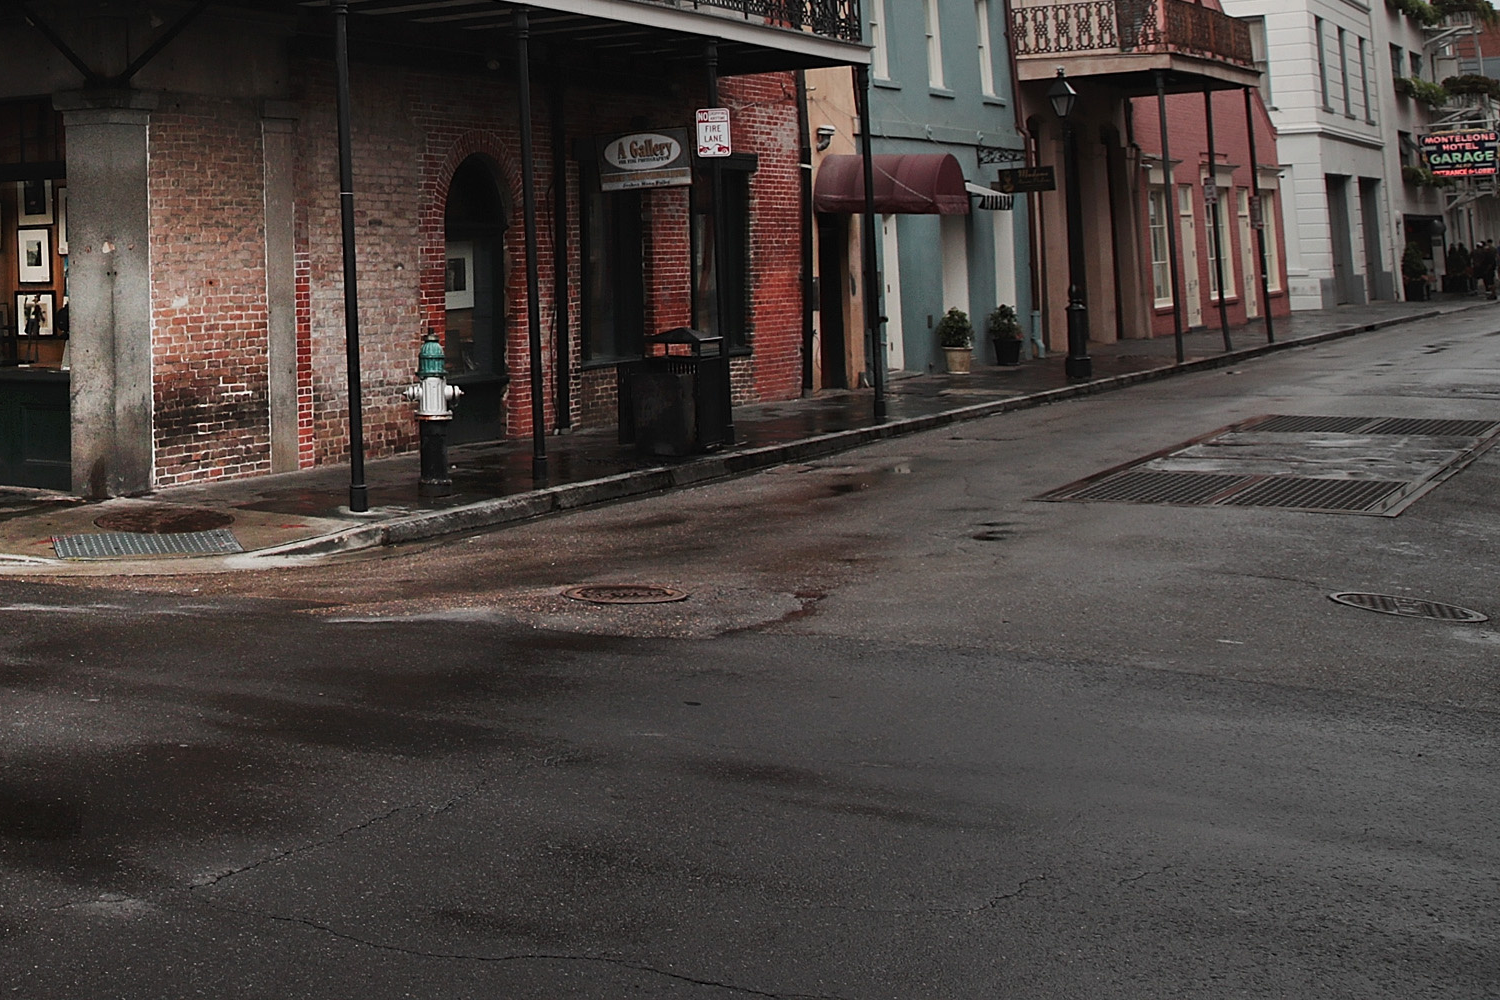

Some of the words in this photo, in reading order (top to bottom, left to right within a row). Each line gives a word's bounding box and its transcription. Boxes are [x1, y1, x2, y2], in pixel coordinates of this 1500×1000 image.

[698, 111, 709, 121] NO
[705, 125, 721, 133] FIRE
[704, 135, 723, 143] LANE
[1424, 133, 1496, 144] MONTELEONE
[618, 142, 627, 159] A
[630, 138, 673, 158] Gallery
[1442, 142, 1479, 151] HOTEL
[1430, 150, 1495, 164] GARAGE
